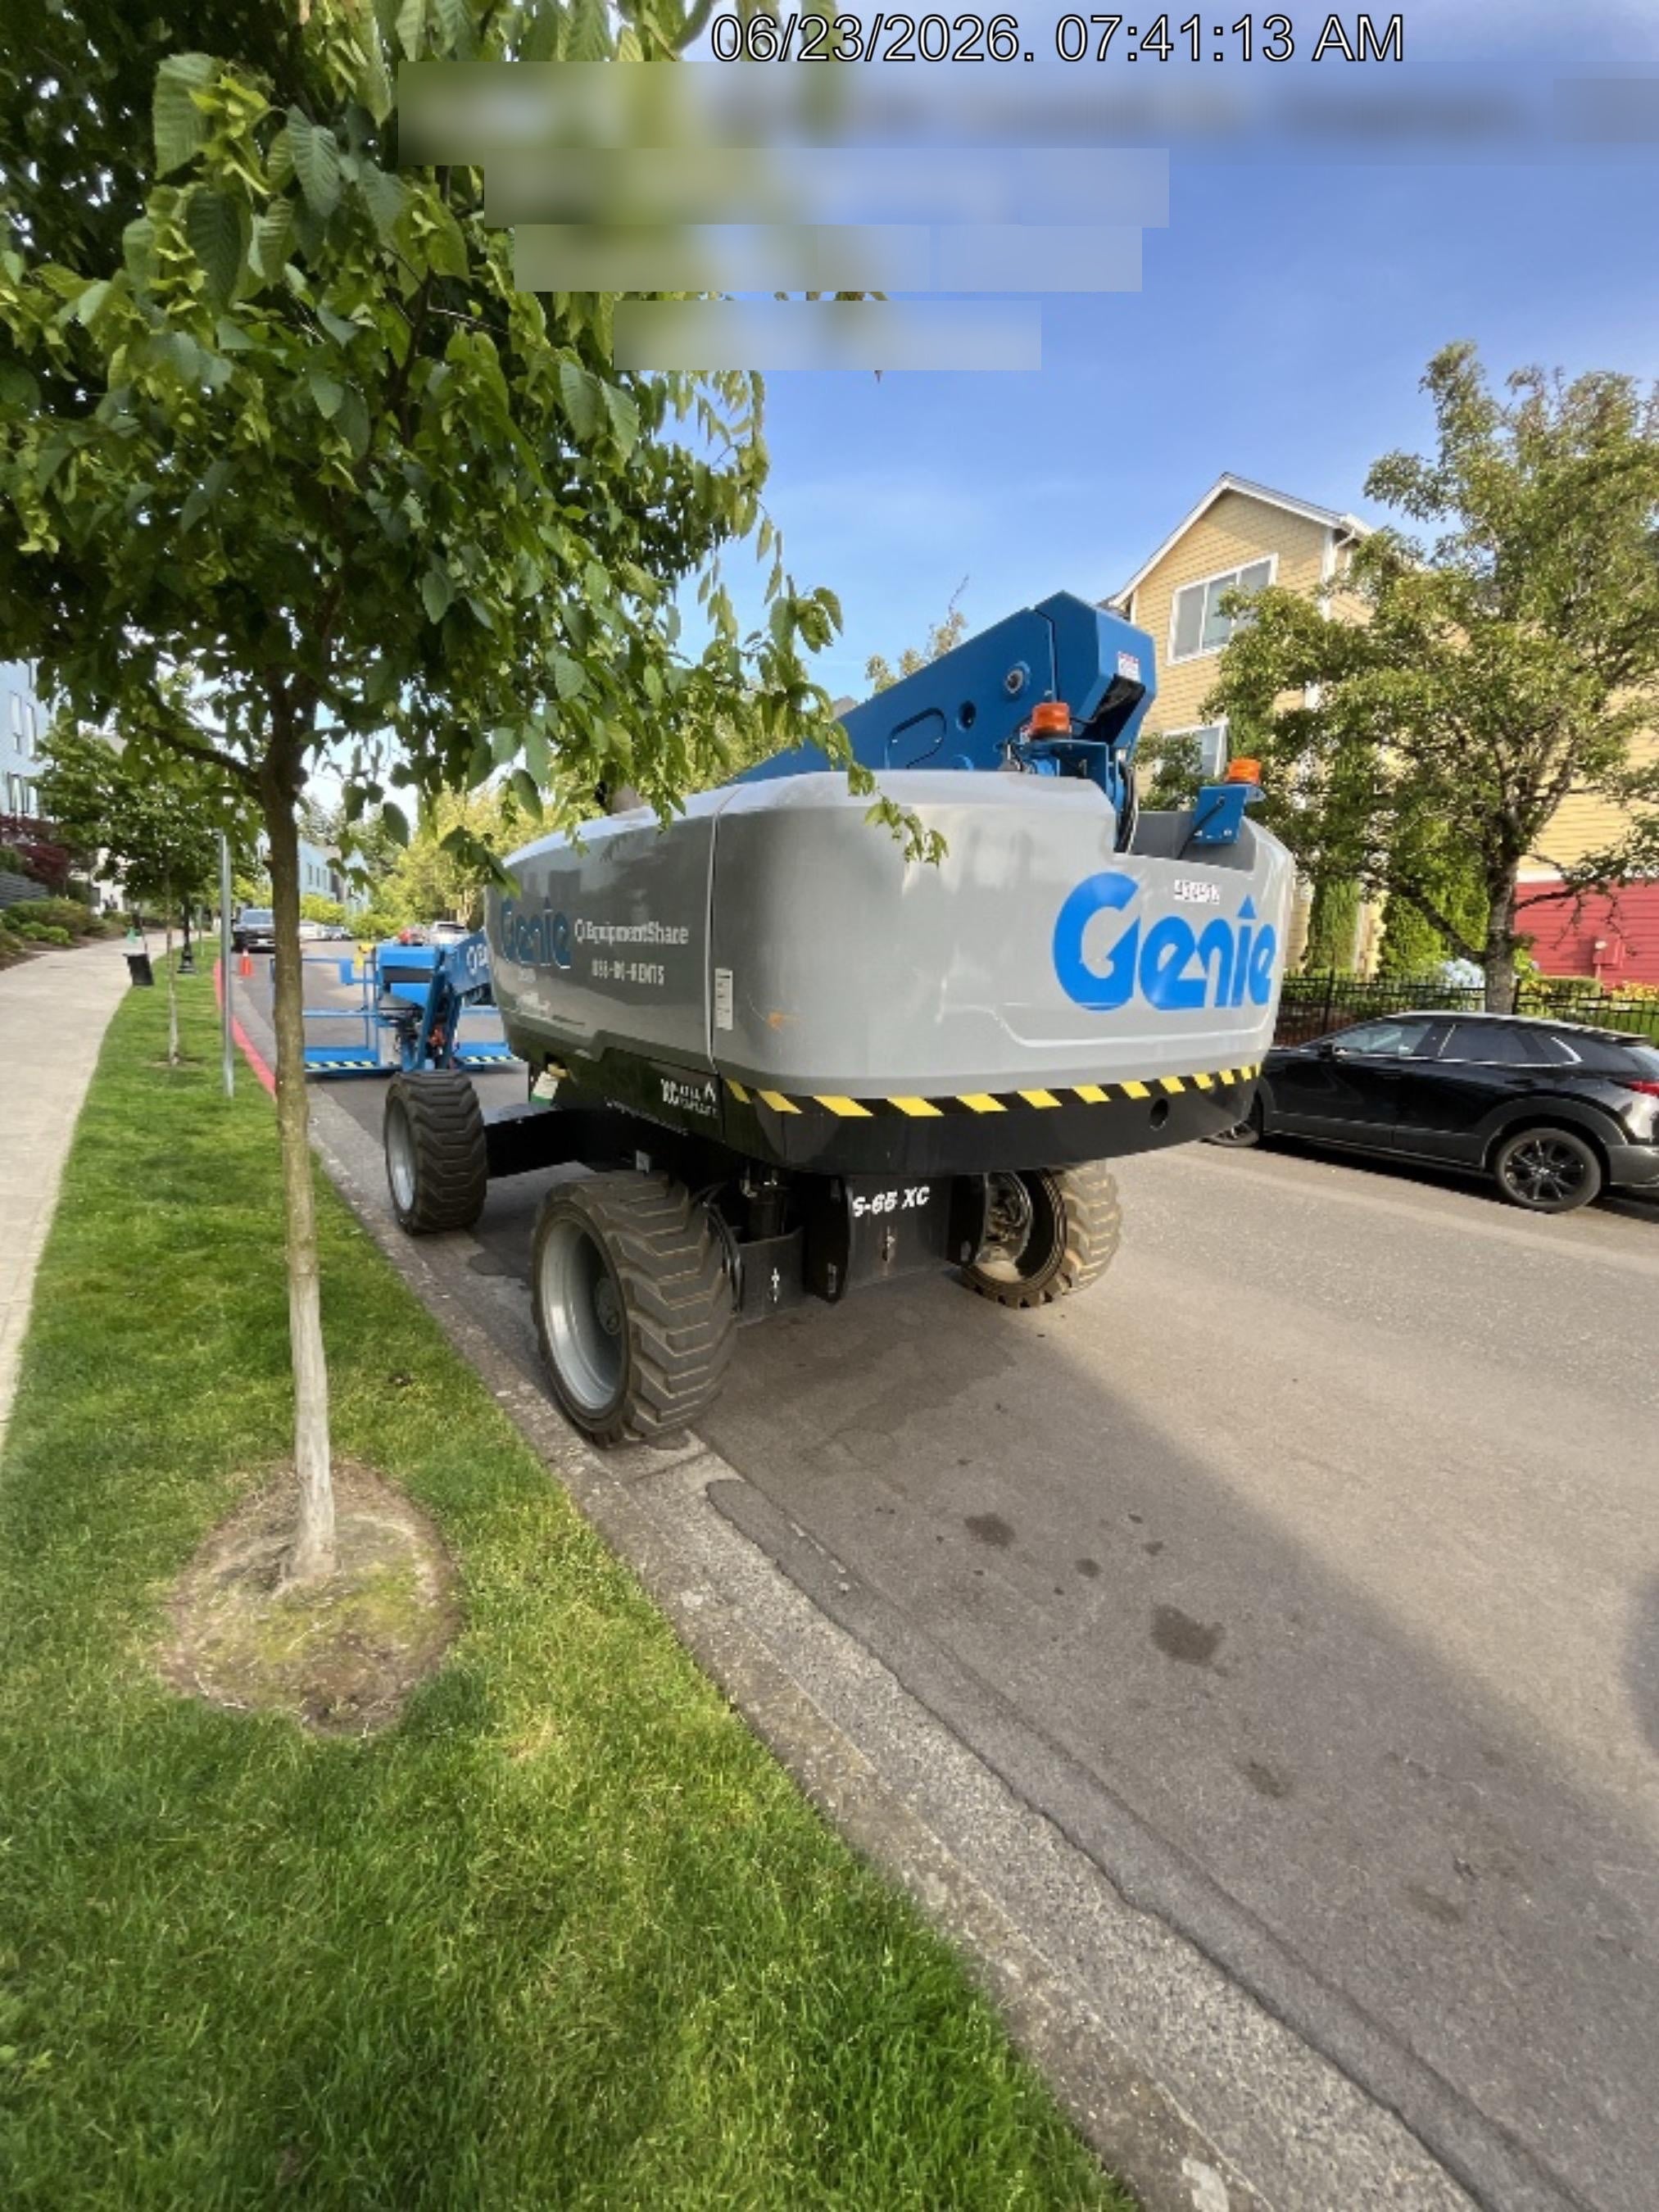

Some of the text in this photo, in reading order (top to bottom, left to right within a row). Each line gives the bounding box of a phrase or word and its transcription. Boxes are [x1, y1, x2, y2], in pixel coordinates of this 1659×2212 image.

[501, 895, 572, 969] Genie
[587, 920, 690, 945] EquipmentShare
[1053, 872, 1276, 1011] Genie
[852, 1185, 931, 1217] S-65 XC
